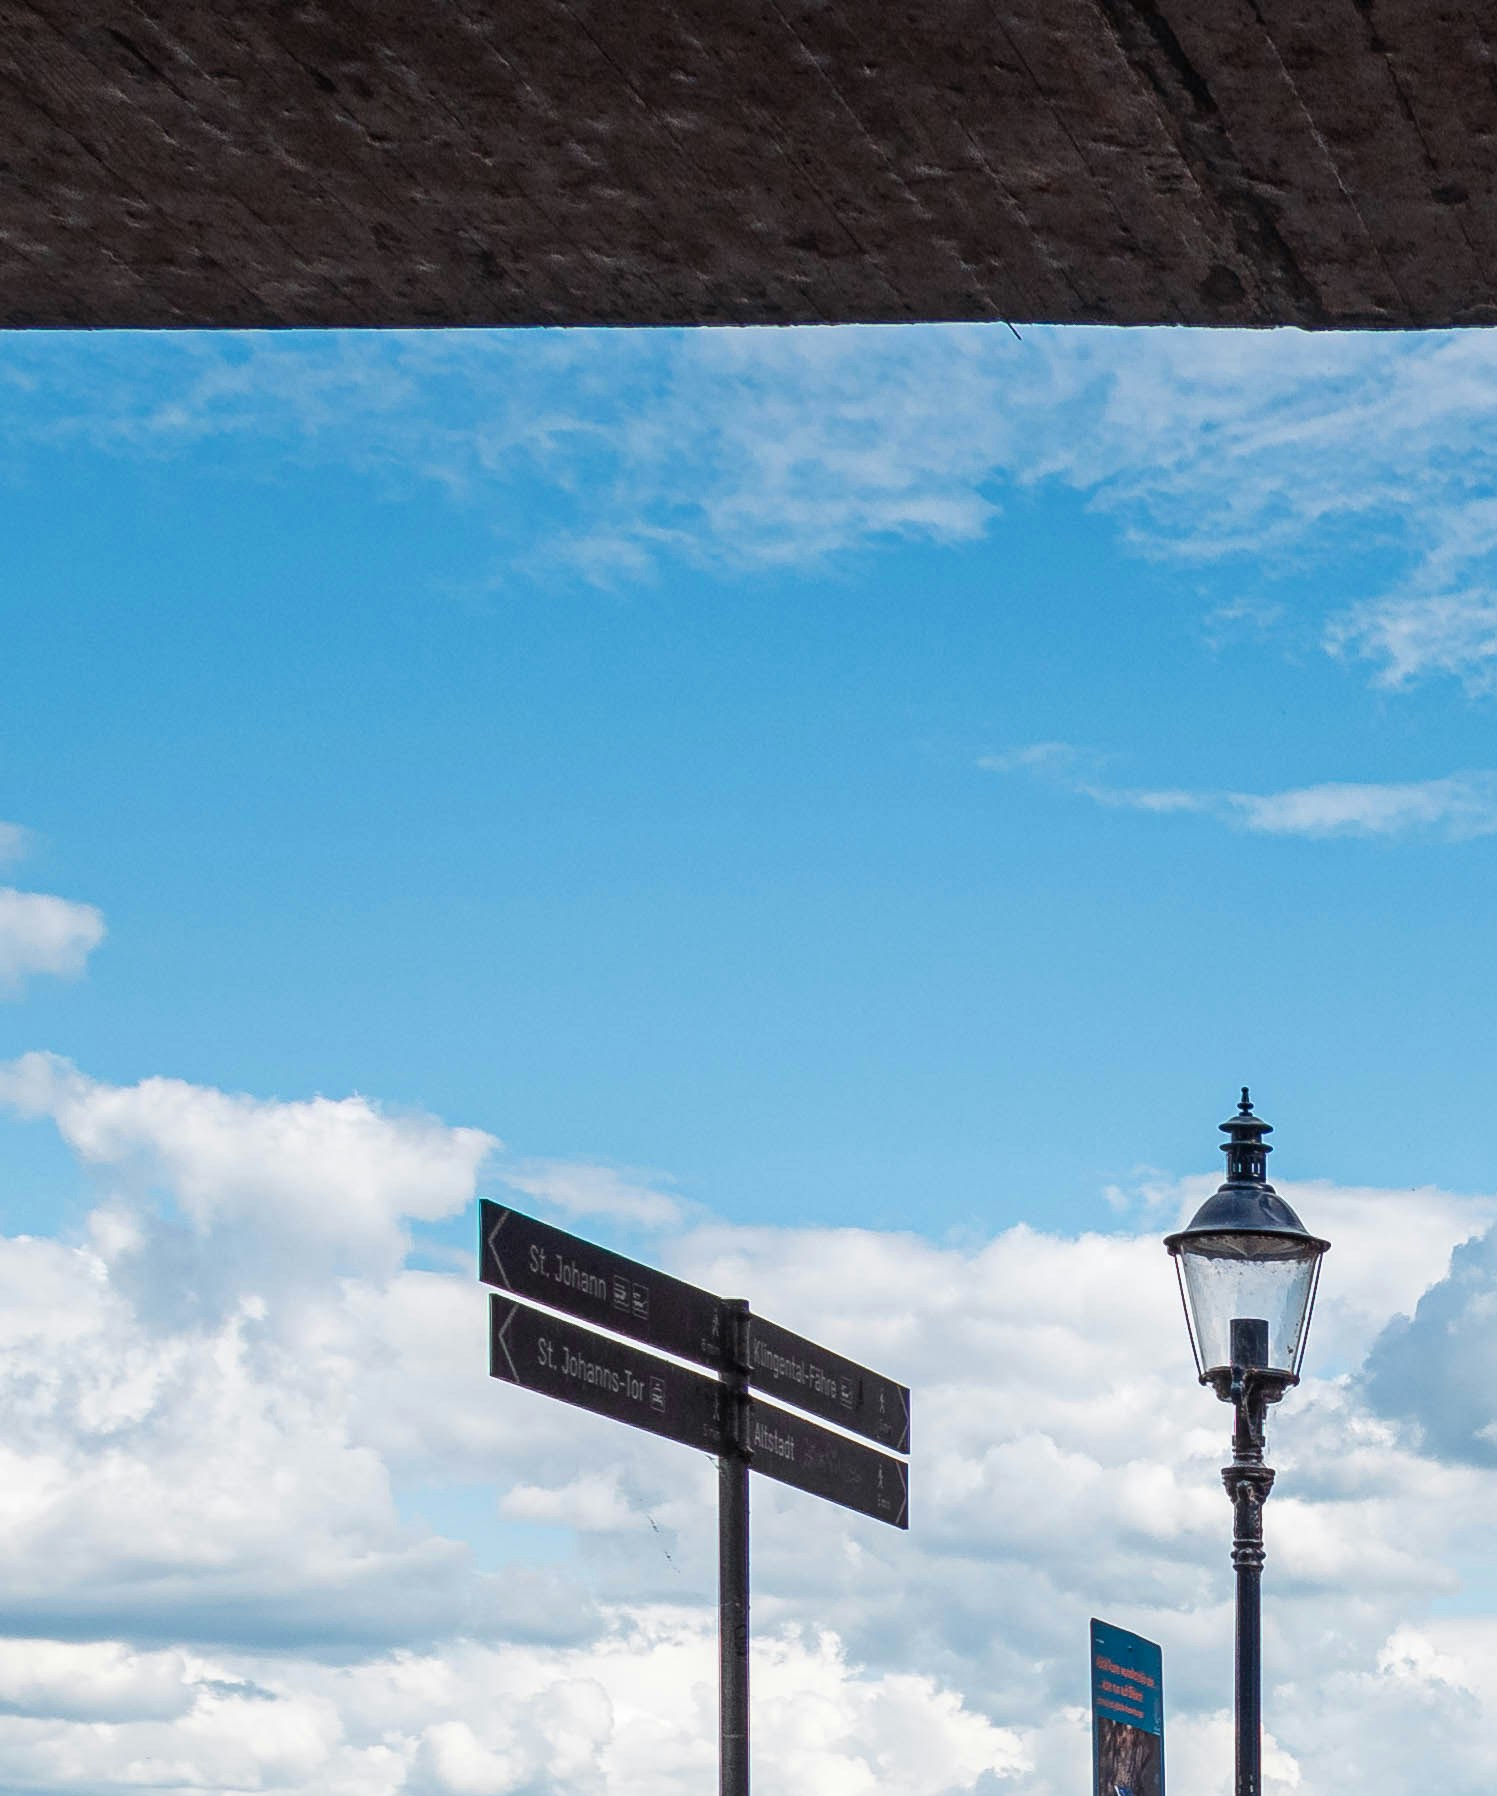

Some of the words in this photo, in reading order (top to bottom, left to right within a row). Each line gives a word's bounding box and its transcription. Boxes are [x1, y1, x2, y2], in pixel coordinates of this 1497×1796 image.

[529, 1244, 550, 1277] St.
[555, 1255, 607, 1300] Johann
[538, 1337, 557, 1371] St.
[561, 1346, 645, 1401] Johanns-Tor
[754, 1422, 795, 1461] Altstadt
